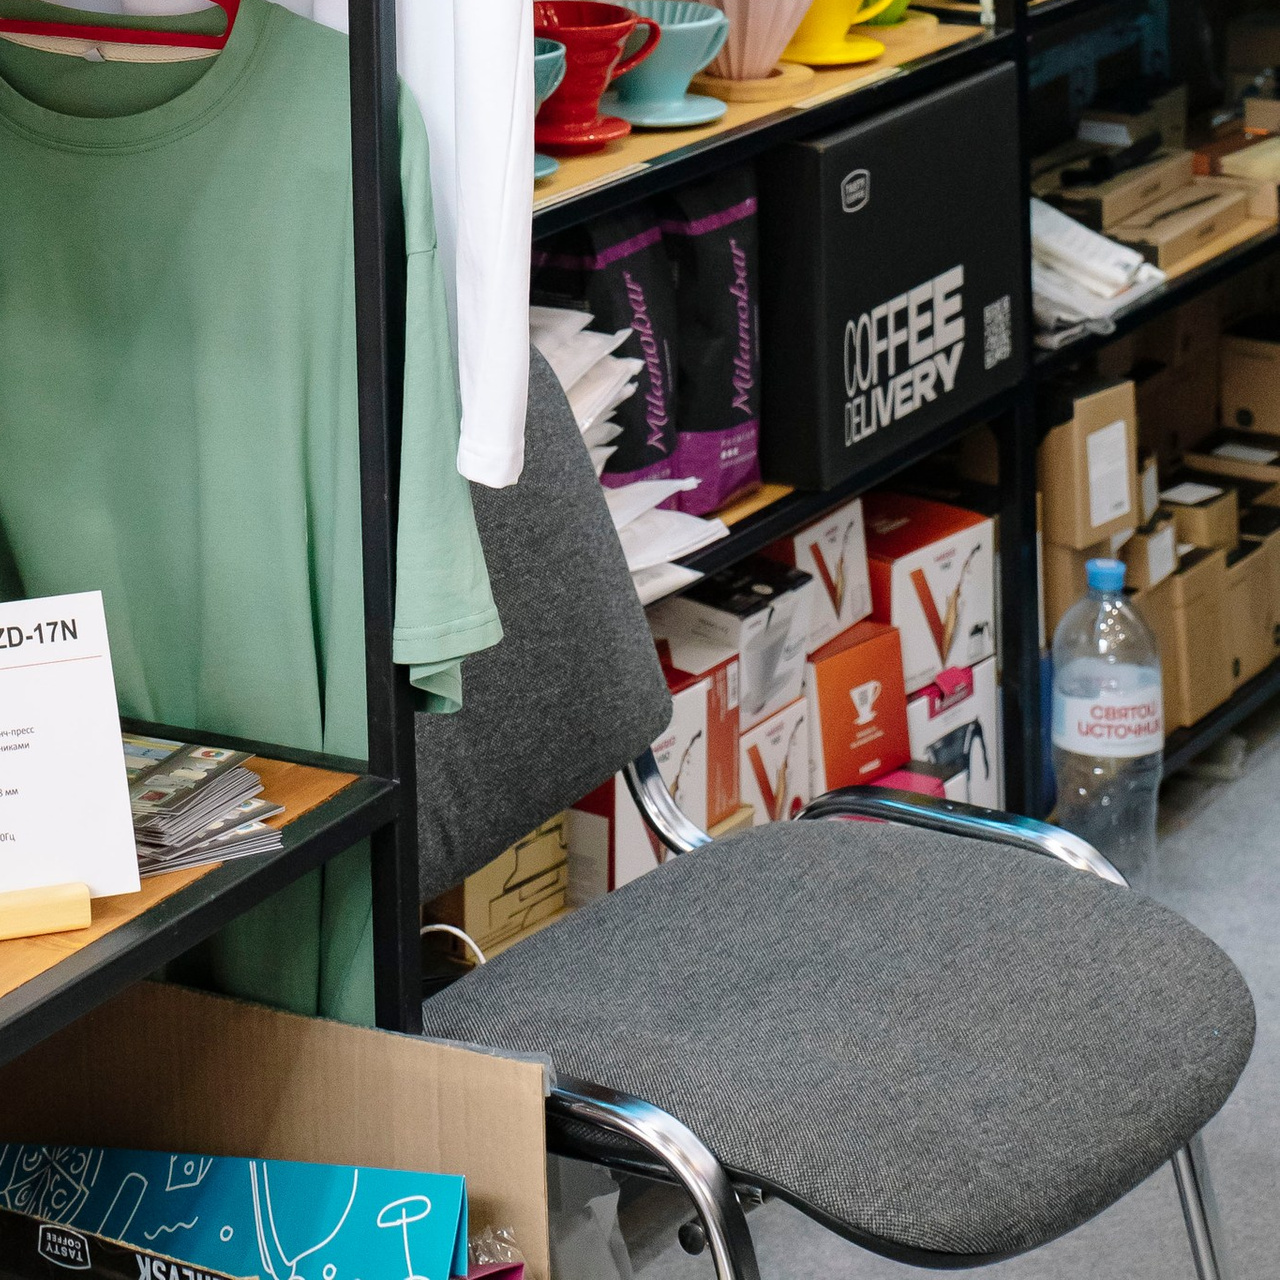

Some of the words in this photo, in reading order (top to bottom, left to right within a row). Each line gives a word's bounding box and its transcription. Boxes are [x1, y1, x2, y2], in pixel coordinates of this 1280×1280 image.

[844, 264, 965, 398] COFFEE
[845, 341, 965, 447] DELIVERY
[5, 788, 18, 796] мм
[46, 1232, 81, 1249] COFFEE
[46, 1243, 83, 1262] TASTY
